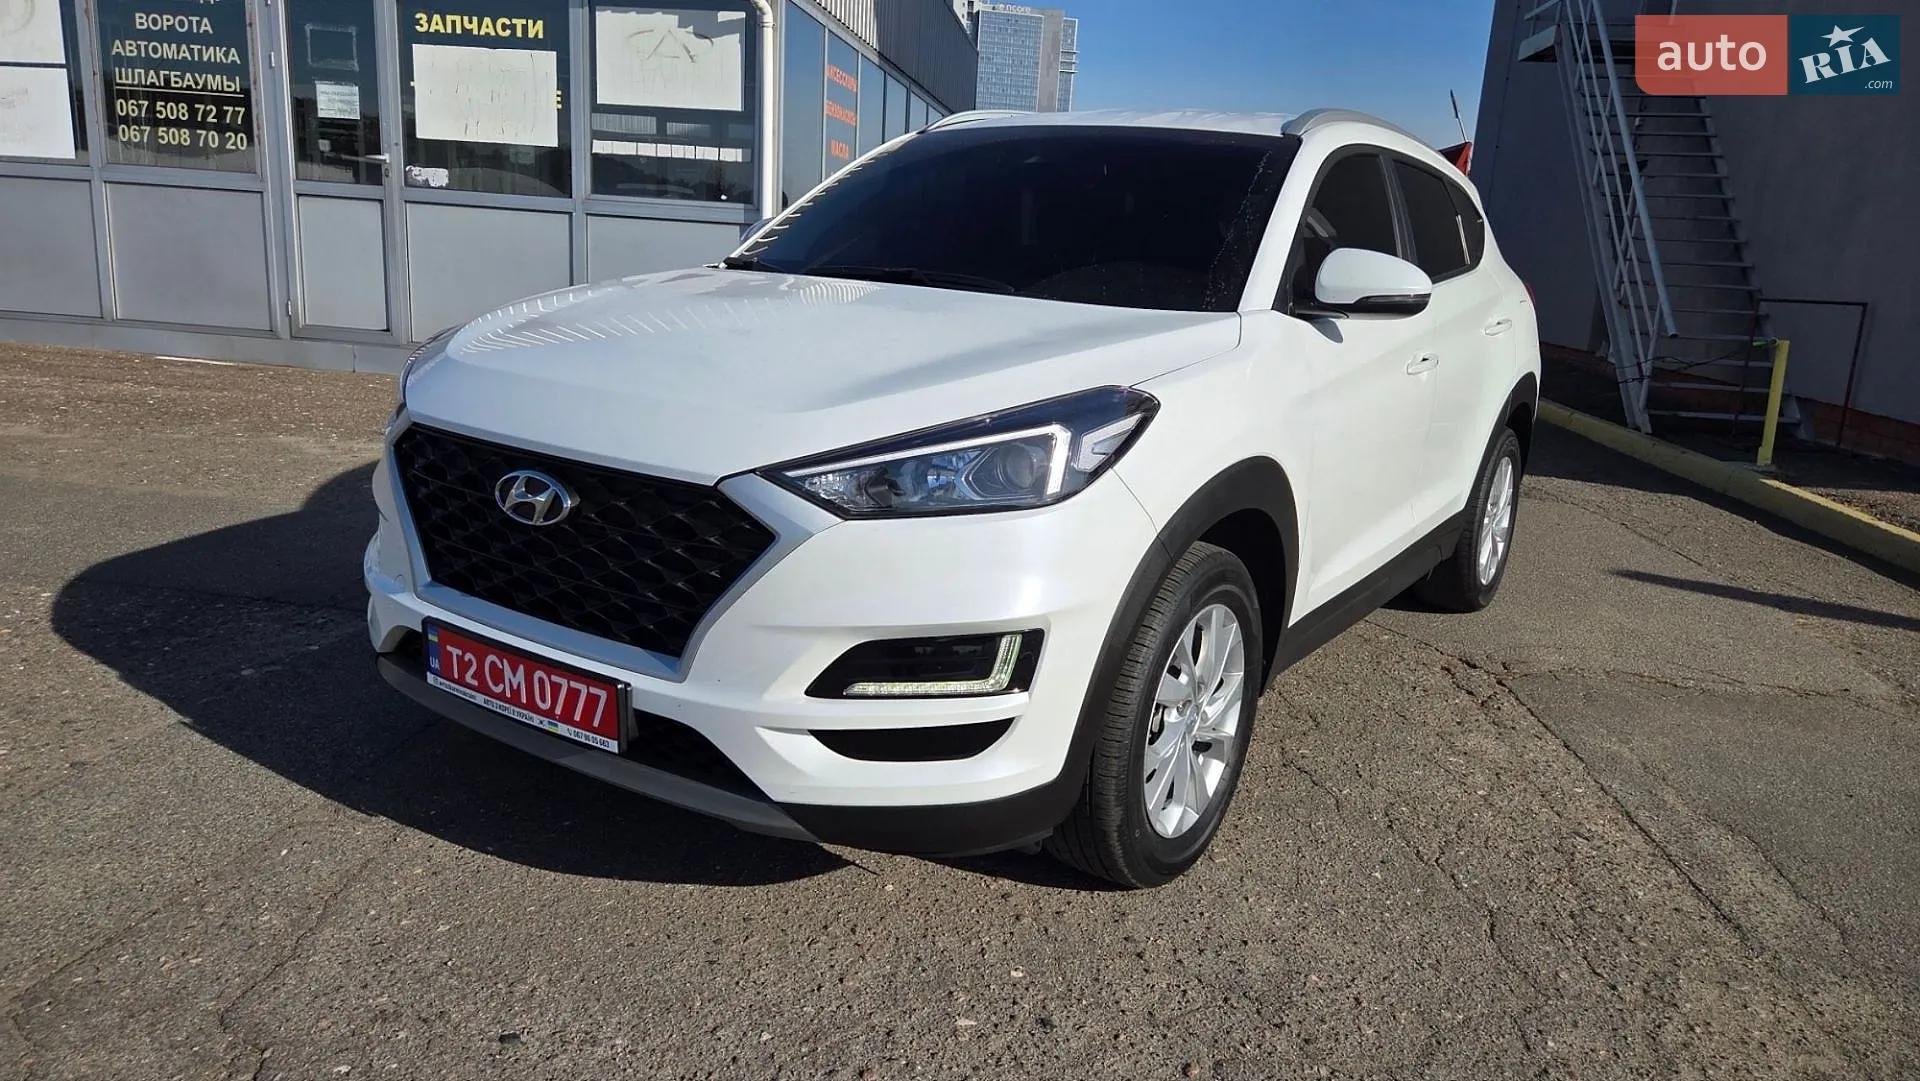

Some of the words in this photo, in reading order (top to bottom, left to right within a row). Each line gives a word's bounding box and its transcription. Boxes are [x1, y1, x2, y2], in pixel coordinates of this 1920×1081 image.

[135, 12, 213, 35] ВОРОТА
[414, 12, 544, 39] ЗАПЧАСТИ
[111, 39, 241, 65] АВТОМАТИКА
[115, 66, 241, 93] ШЛАГБАУМЫ
[116, 99, 149, 118] 067
[156, 102, 189, 121] 508
[195, 104, 217, 123] 72
[223, 106, 246, 125] 77
[118, 124, 151, 143] 067
[157, 127, 190, 146] 508
[197, 130, 219, 148] 70
[225, 132, 247, 150] 20
[429, 656, 440, 671] UA
[446, 645, 478, 686] T2
[484, 654, 527, 704] CM
[533, 670, 608, 728] 0777
